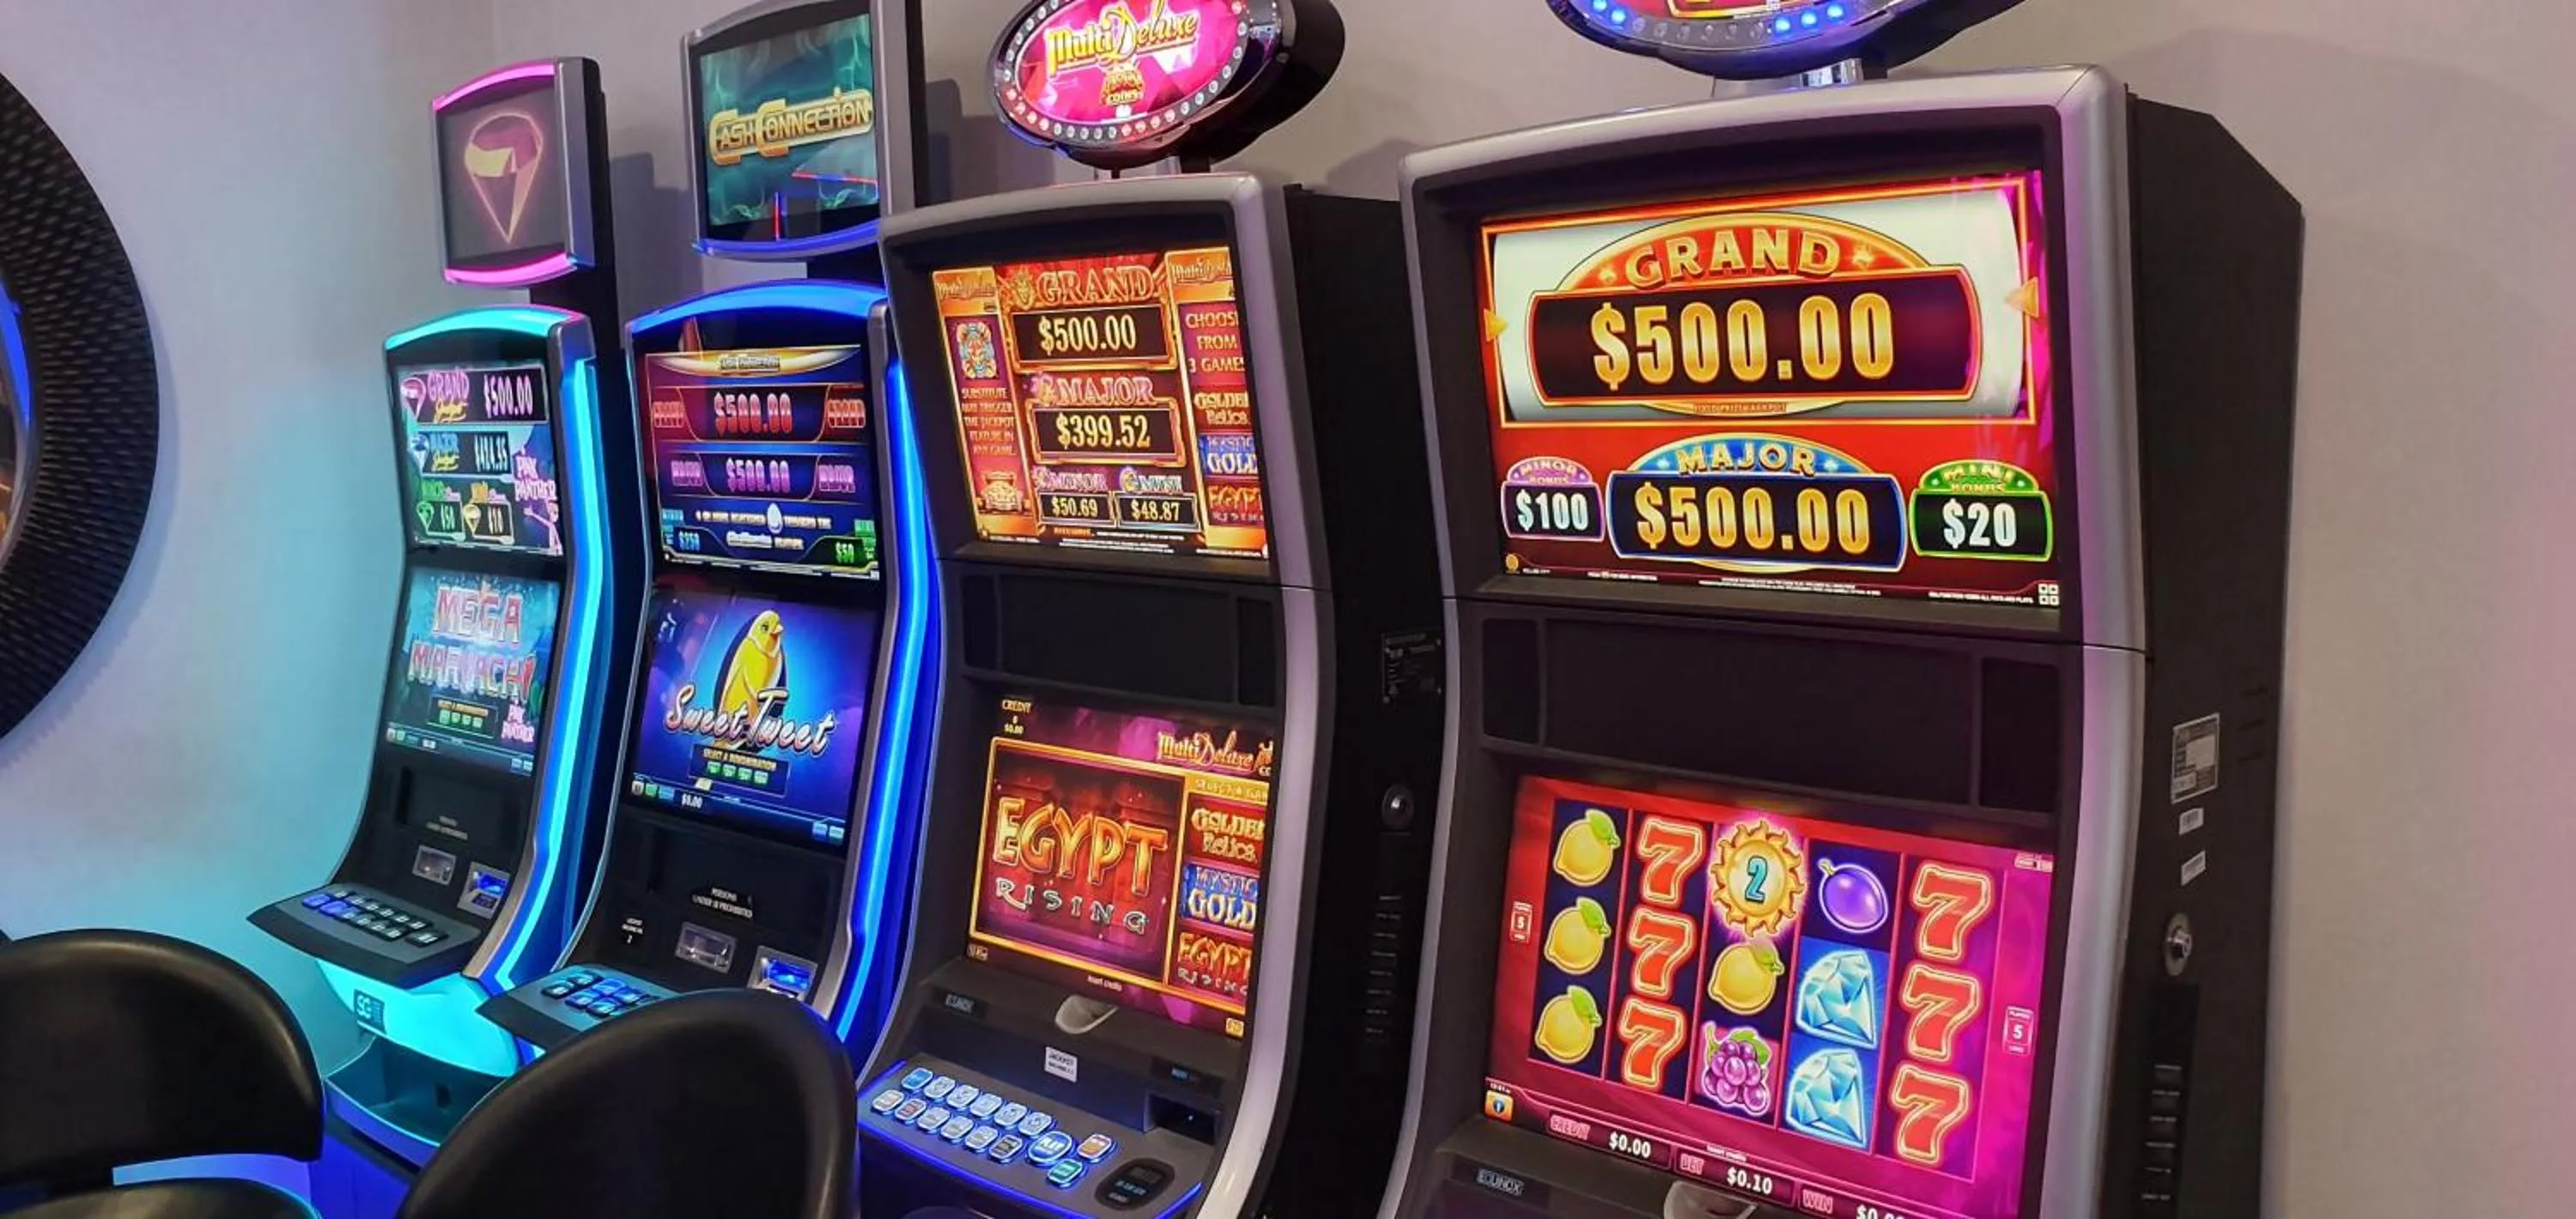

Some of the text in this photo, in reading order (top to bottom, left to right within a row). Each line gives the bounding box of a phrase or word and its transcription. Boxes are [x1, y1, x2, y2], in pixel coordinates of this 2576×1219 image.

[1625, 227, 1841, 289] GRAND
[1036, 265, 1155, 302] GRAND
[1038, 314, 1137, 355] $500.00
[1185, 312, 1238, 329] CHOOS
[1590, 292, 1894, 390] $500.00
[1196, 335, 1237, 350] FROM
[1188, 359, 1197, 373] 3
[428, 367, 534, 418] GRAND $500.00
[1057, 377, 1154, 405] MAJOR
[714, 391, 793, 436] $500.00
[1055, 412, 1151, 449] $399.52
[726, 458, 791, 493] $500.00
[1520, 460, 1577, 476] MINOR
[1676, 441, 1815, 478] MAJOR
[1943, 464, 2014, 483] MINI
[1051, 496, 1180, 522] $50.69 $48.87
[1516, 488, 1589, 531] $100
[1950, 482, 2007, 494] BONUS
[1634, 481, 1870, 555] $500.00
[1942, 499, 2017, 549] $20
[835, 541, 854, 563] $50
[431, 584, 523, 645] MEGA
[407, 640, 536, 703] MARIACHI
[665, 683, 835, 757] Sweet Tweet
[1002, 699, 1031, 713] CREDIT
[993, 796, 1169, 895] EGYPT
[1637, 818, 1704, 904] 7
[1743, 854, 1769, 905] 2
[995, 876, 1149, 936] RISING
[1188, 888, 1257, 931] GOLD
[1911, 864, 1992, 960] 7
[1629, 907, 1694, 995] 7
[1901, 963, 1982, 1062] 7
[2012, 1023, 2024, 1040] 5
[1619, 997, 1685, 1087] 7
[1549, 1114, 1652, 1159] CREDIT $0.00
[1892, 1065, 1970, 1166] 7
[1477, 1168, 1524, 1196] EQUINOX
[1680, 1153, 1773, 1195] BET $0.10
[1802, 1188, 1834, 1214] WIN
